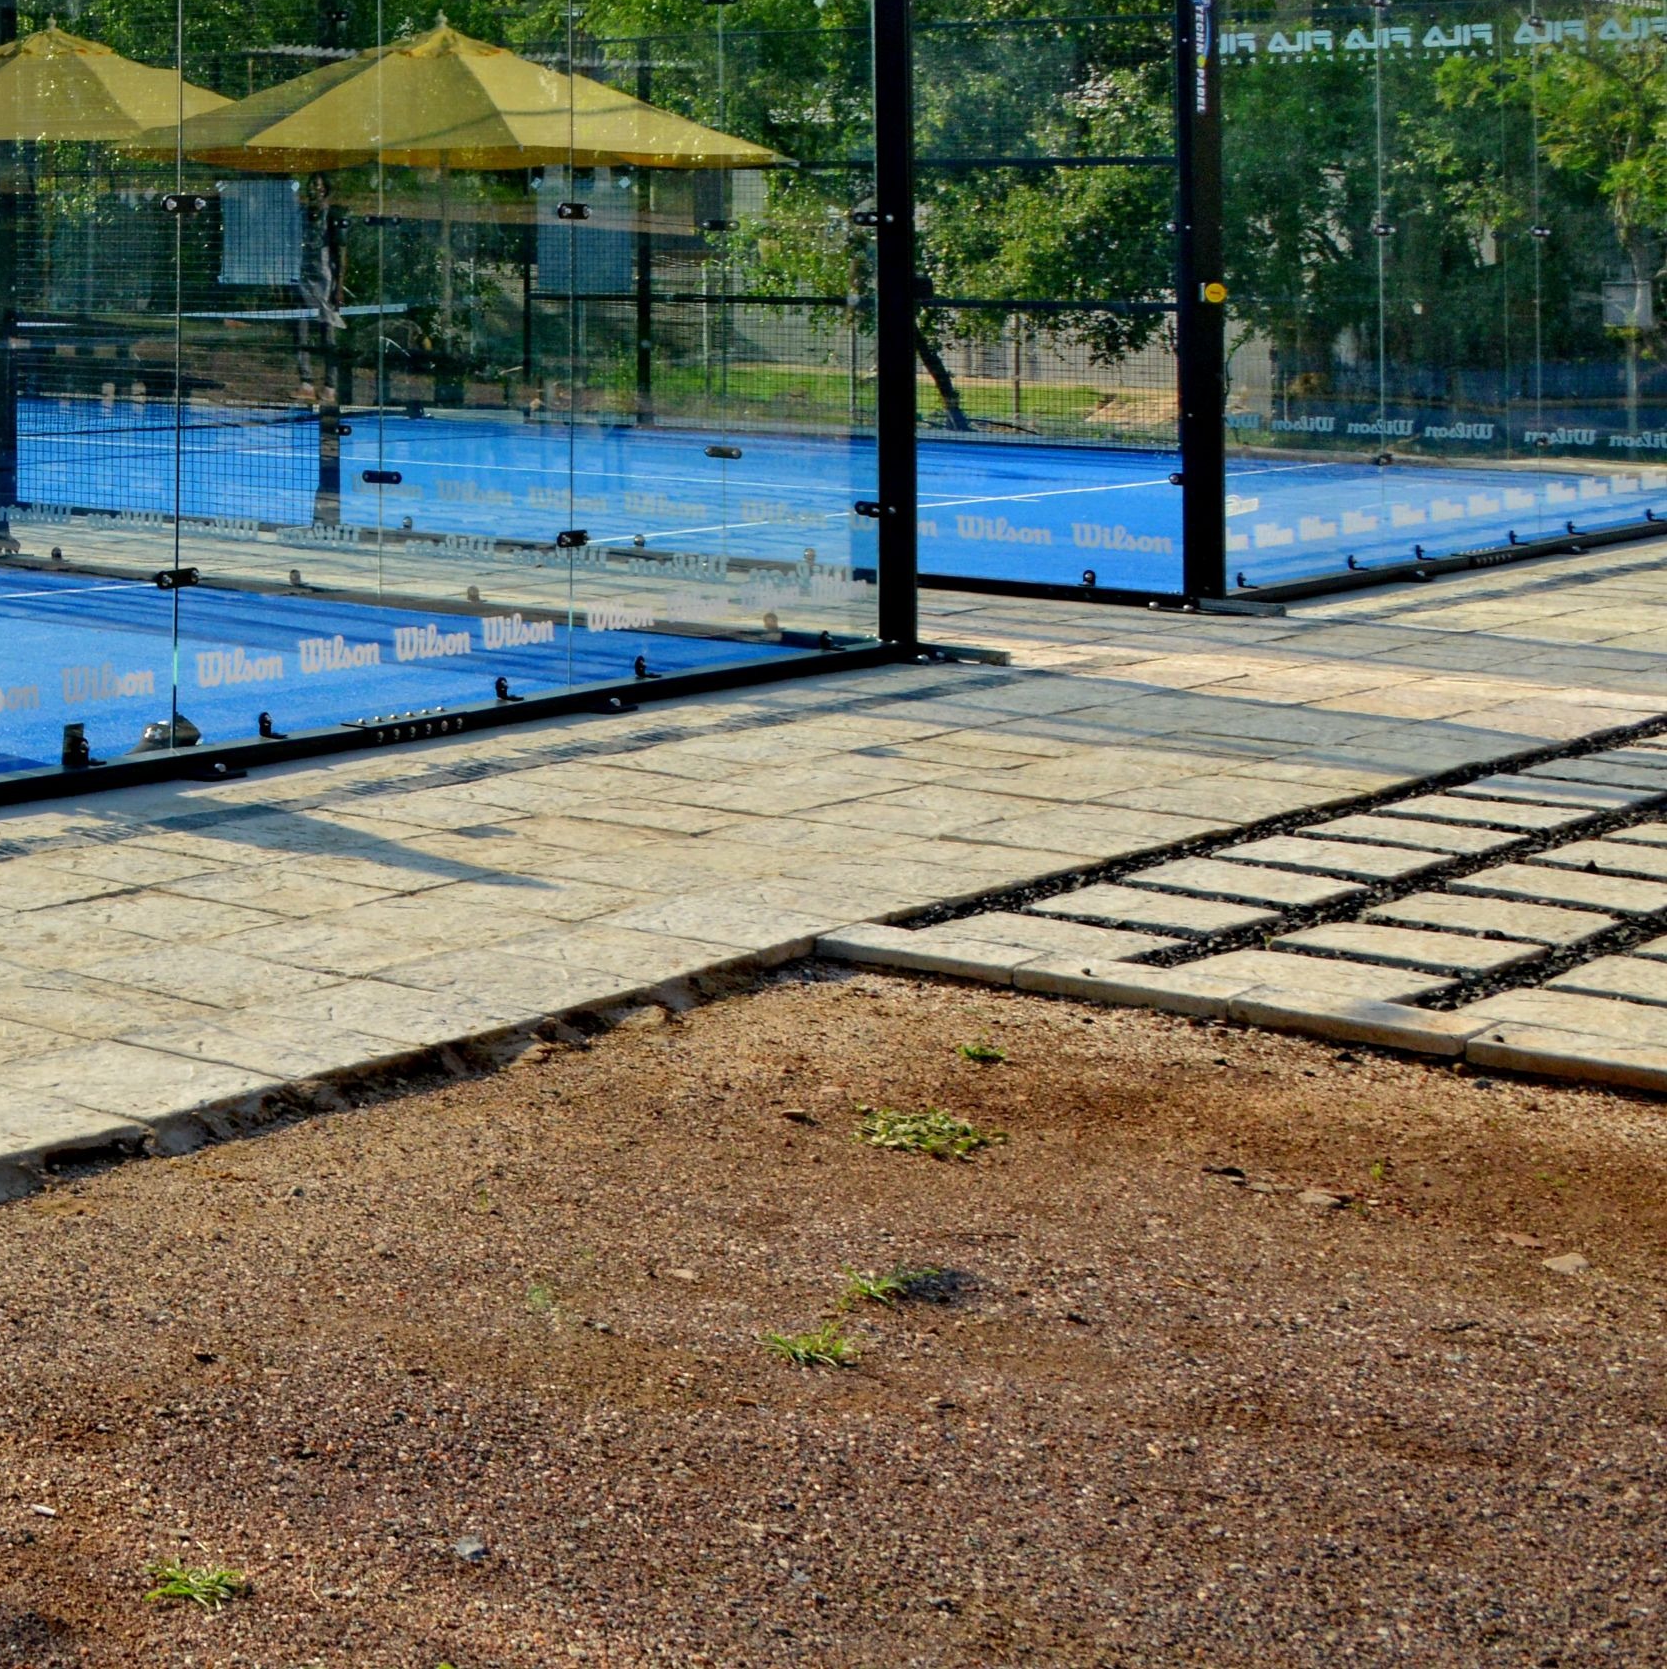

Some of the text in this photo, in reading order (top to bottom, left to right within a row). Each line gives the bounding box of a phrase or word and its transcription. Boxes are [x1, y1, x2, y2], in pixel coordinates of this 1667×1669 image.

[956, 515, 1172, 555] Wilson Wilson
[197, 613, 553, 688] Wilson Wilson Wilson Wilson
[61, 662, 154, 702] Wilson
